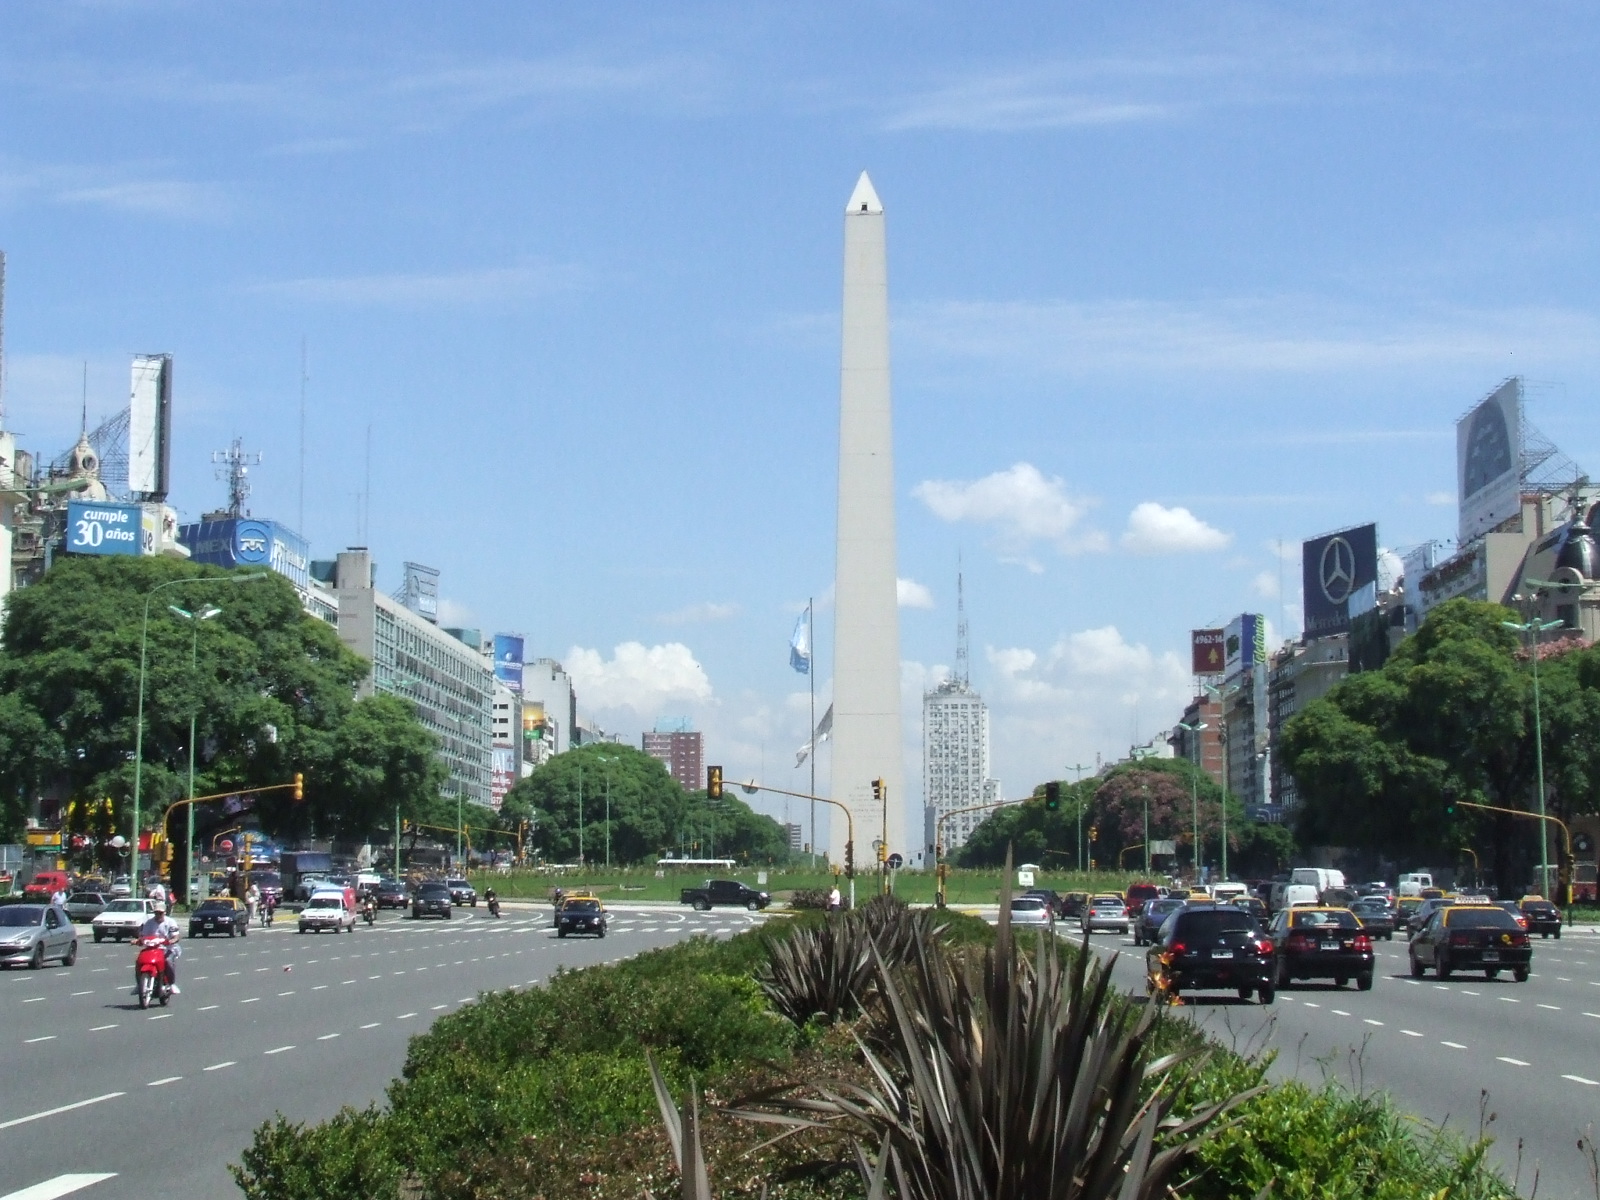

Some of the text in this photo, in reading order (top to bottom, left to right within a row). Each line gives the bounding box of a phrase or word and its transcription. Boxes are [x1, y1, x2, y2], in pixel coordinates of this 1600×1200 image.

[83, 510, 128, 524] cumple
[73, 520, 135, 547] 30 años
